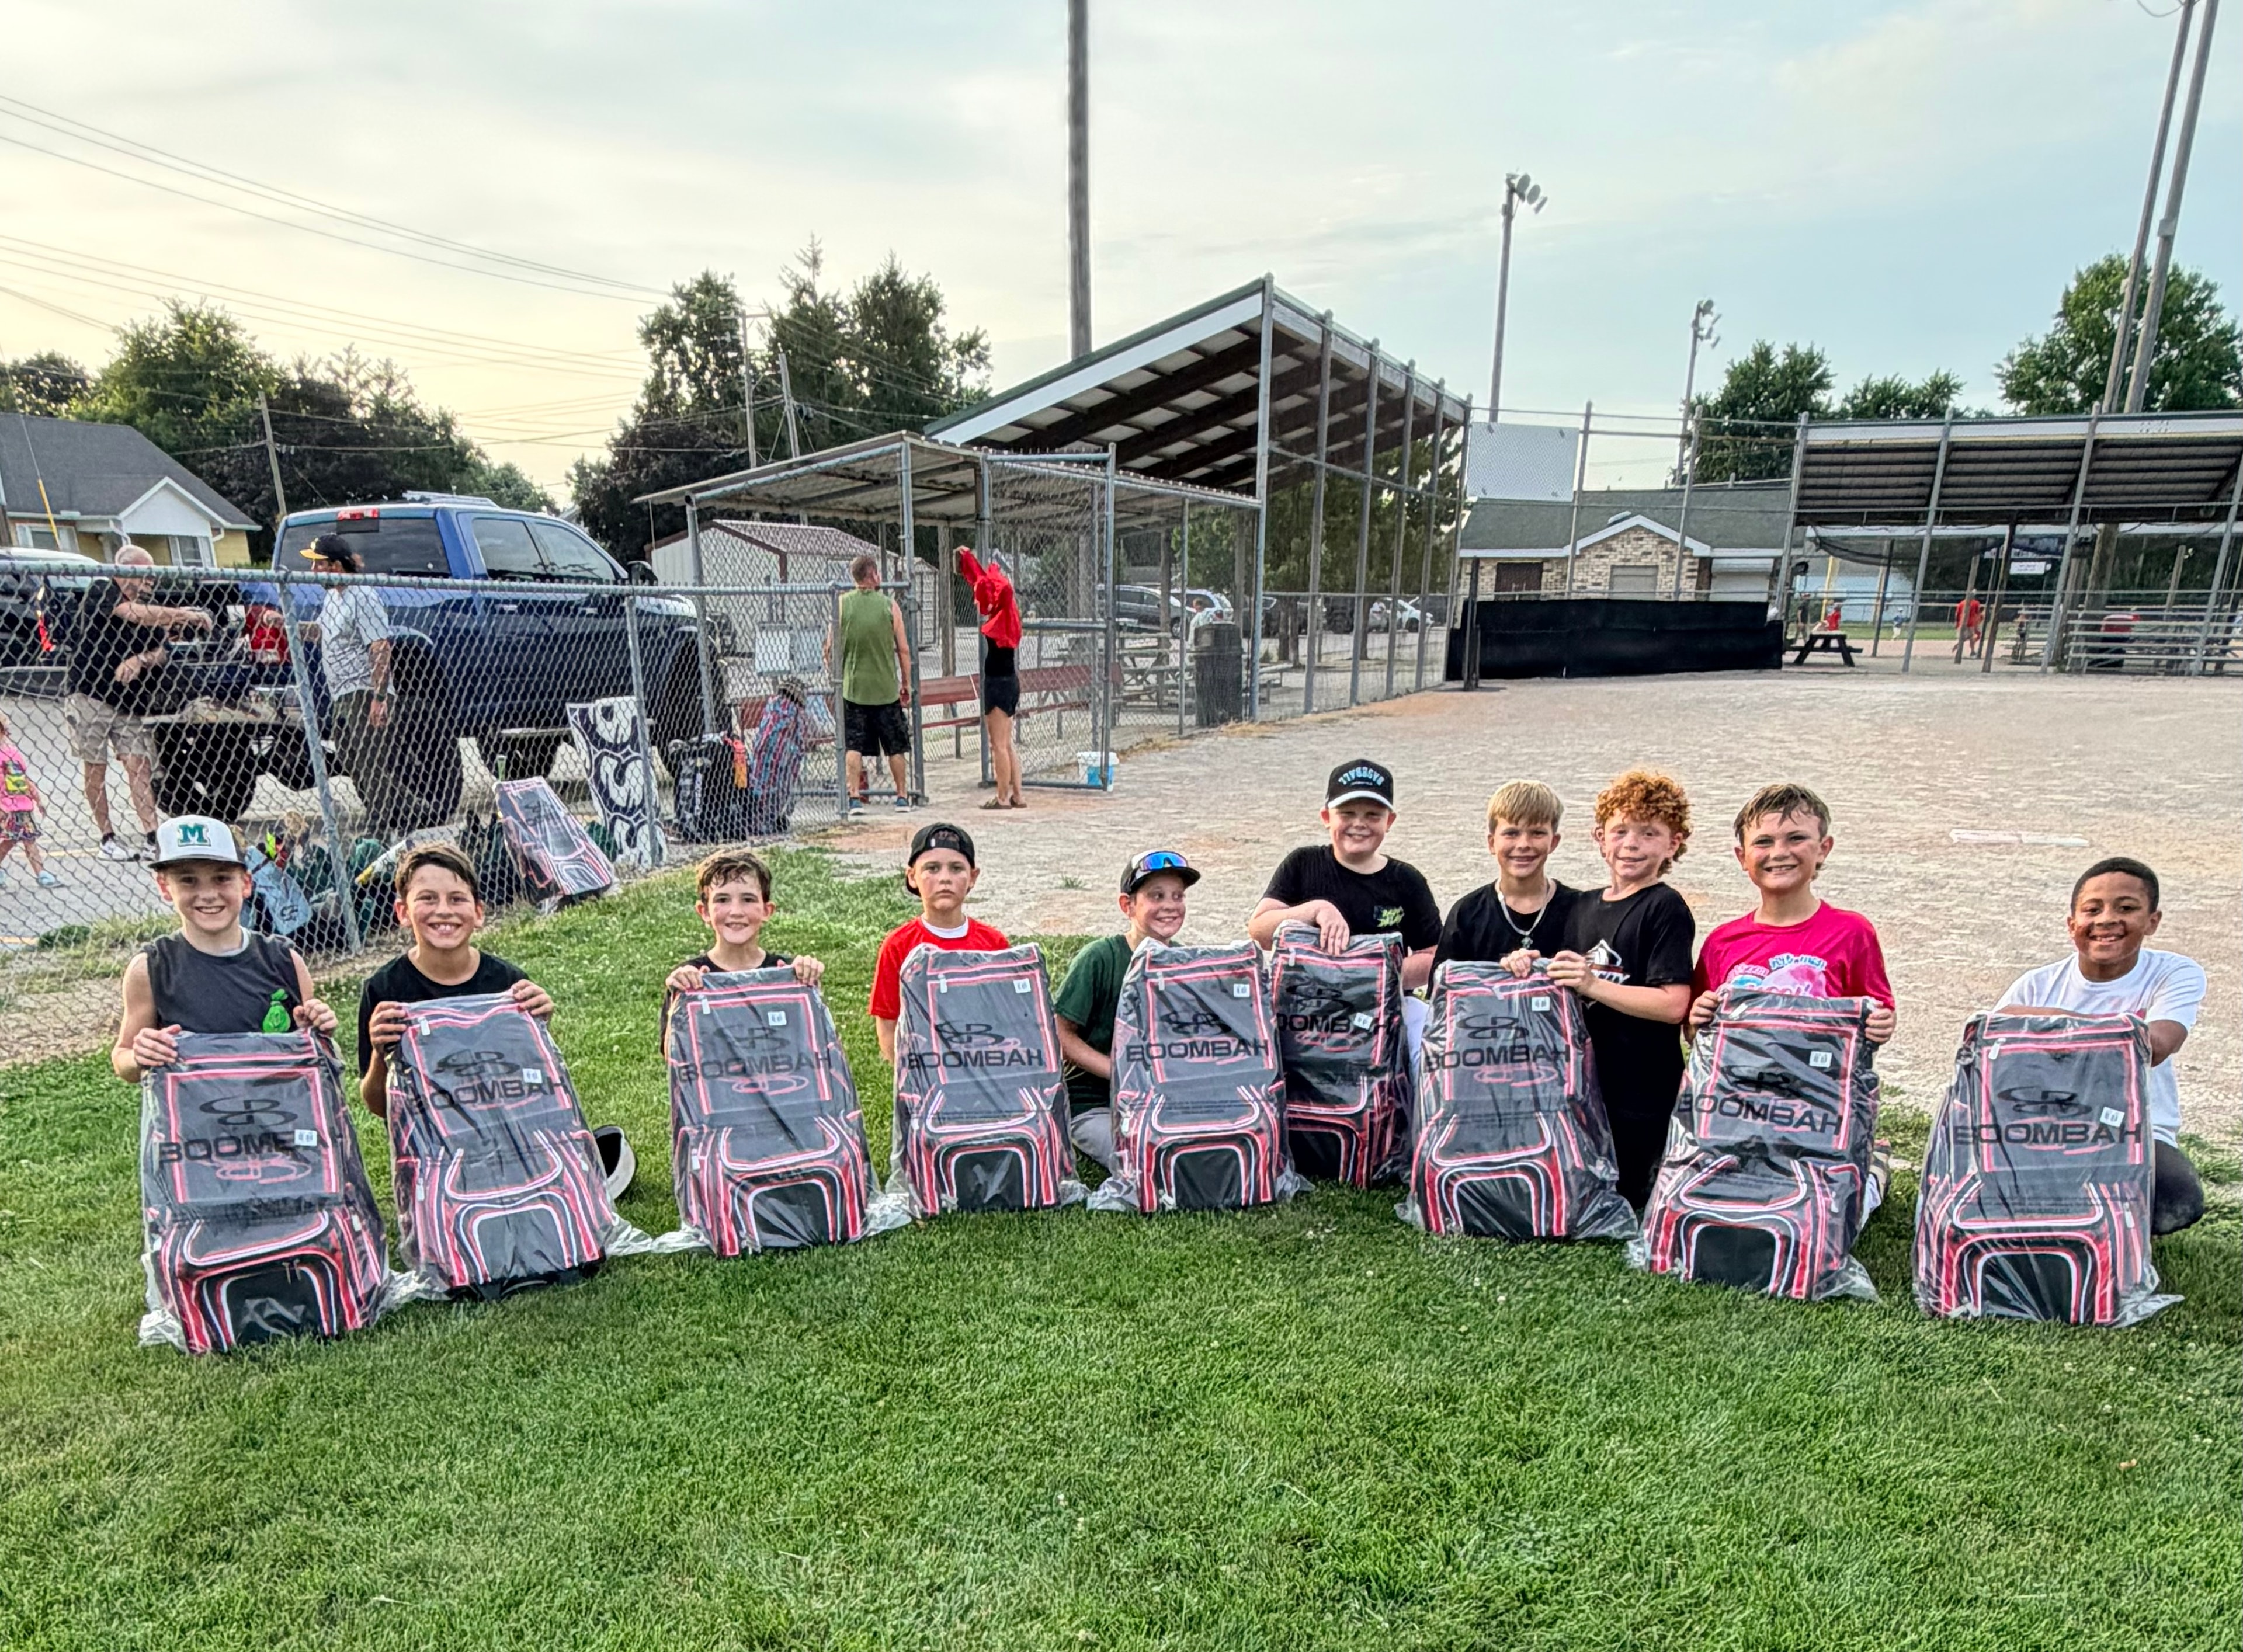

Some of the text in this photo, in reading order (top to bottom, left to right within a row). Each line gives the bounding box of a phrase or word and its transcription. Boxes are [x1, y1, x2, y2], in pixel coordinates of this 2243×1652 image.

[178, 823, 210, 845] M
[908, 1048, 1043, 1070] BOOMBAH
[1126, 1038, 1269, 1062] BOOMBAH
[1425, 1044, 1571, 1073] BOOMBAH
[679, 1051, 832, 1082] BOOMBAH
[1678, 1094, 1843, 1136] BOOMBAH
[1954, 1123, 2142, 1145] BOOMBAH
